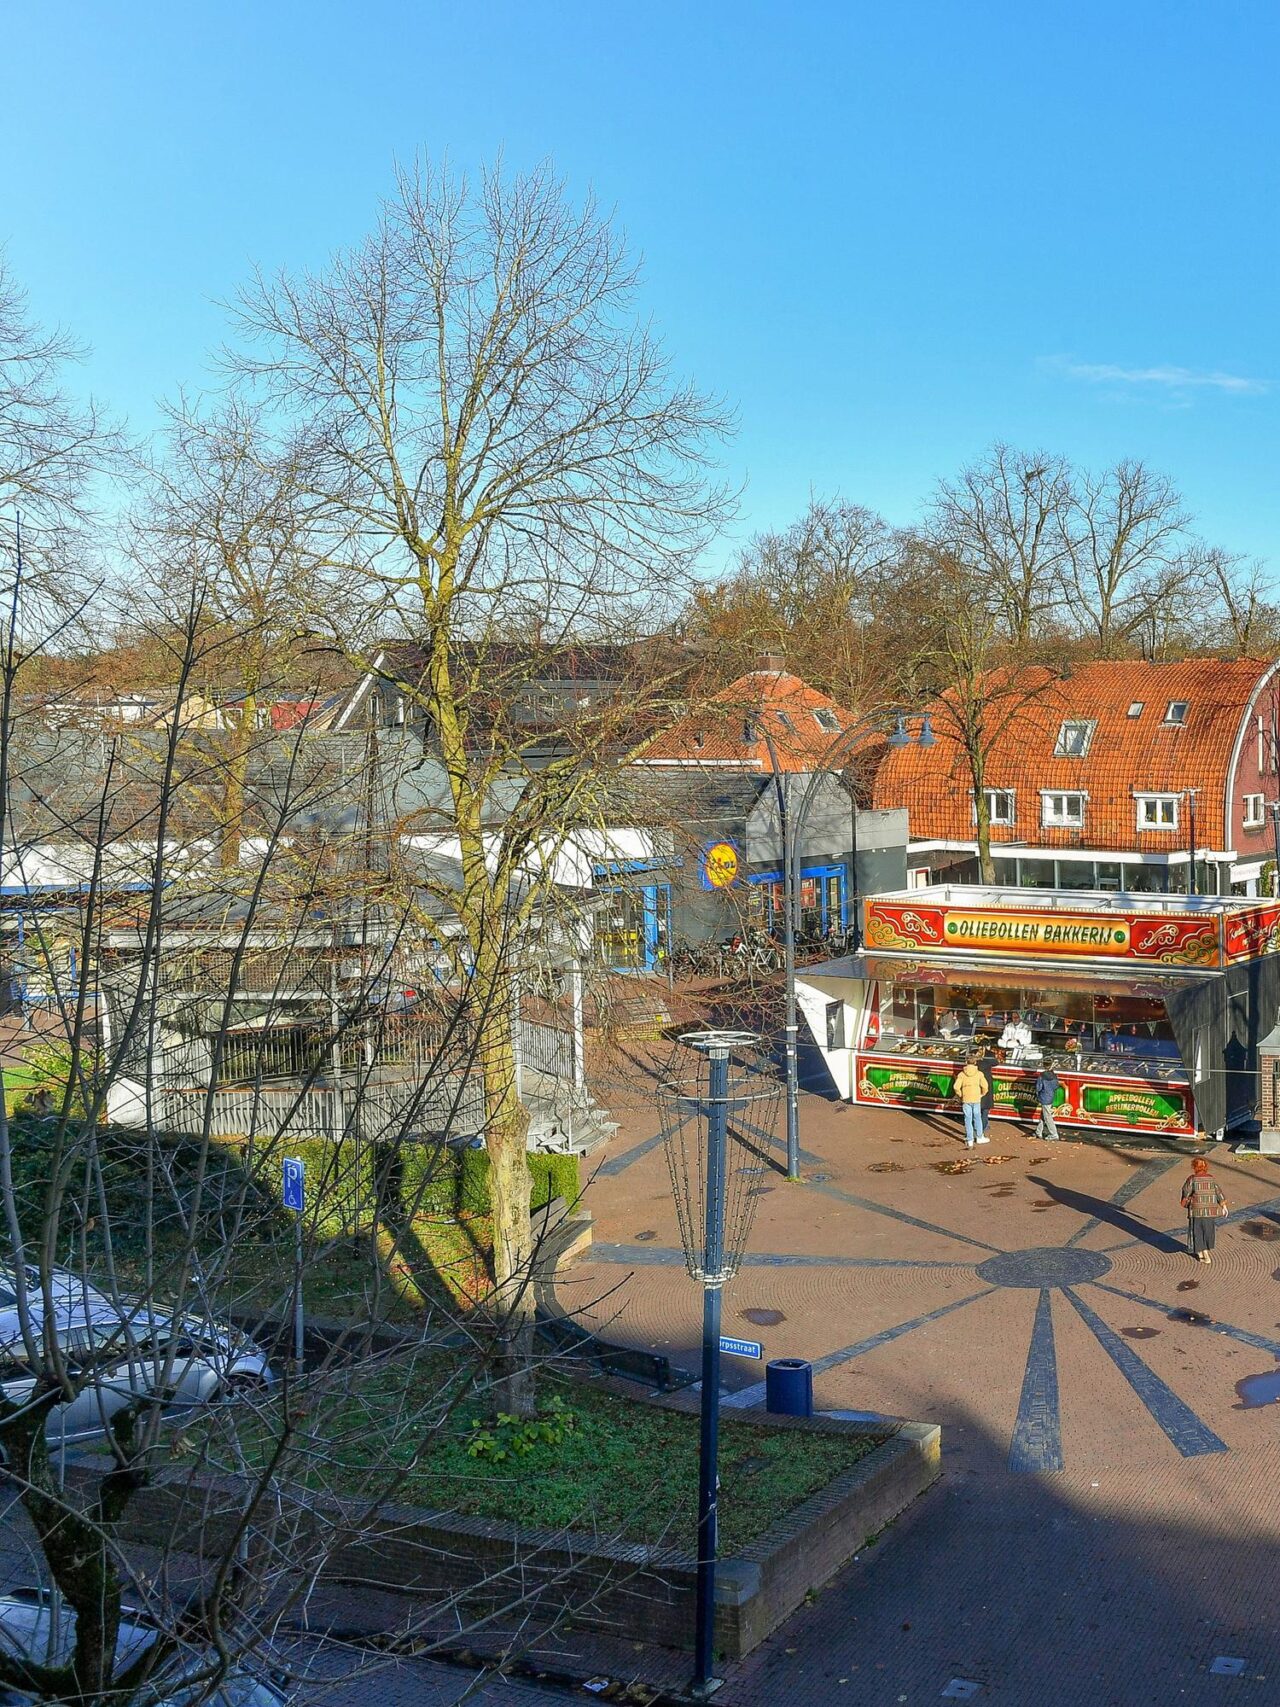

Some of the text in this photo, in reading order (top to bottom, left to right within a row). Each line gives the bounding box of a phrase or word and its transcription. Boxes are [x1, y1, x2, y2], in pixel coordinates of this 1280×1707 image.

[959, 920, 1113, 946] OLIEBOLLEN BAKKERIJ
[1109, 1093, 1156, 1106] APPELBOLLEN
[720, 1341, 756, 1353] rpsstraat
